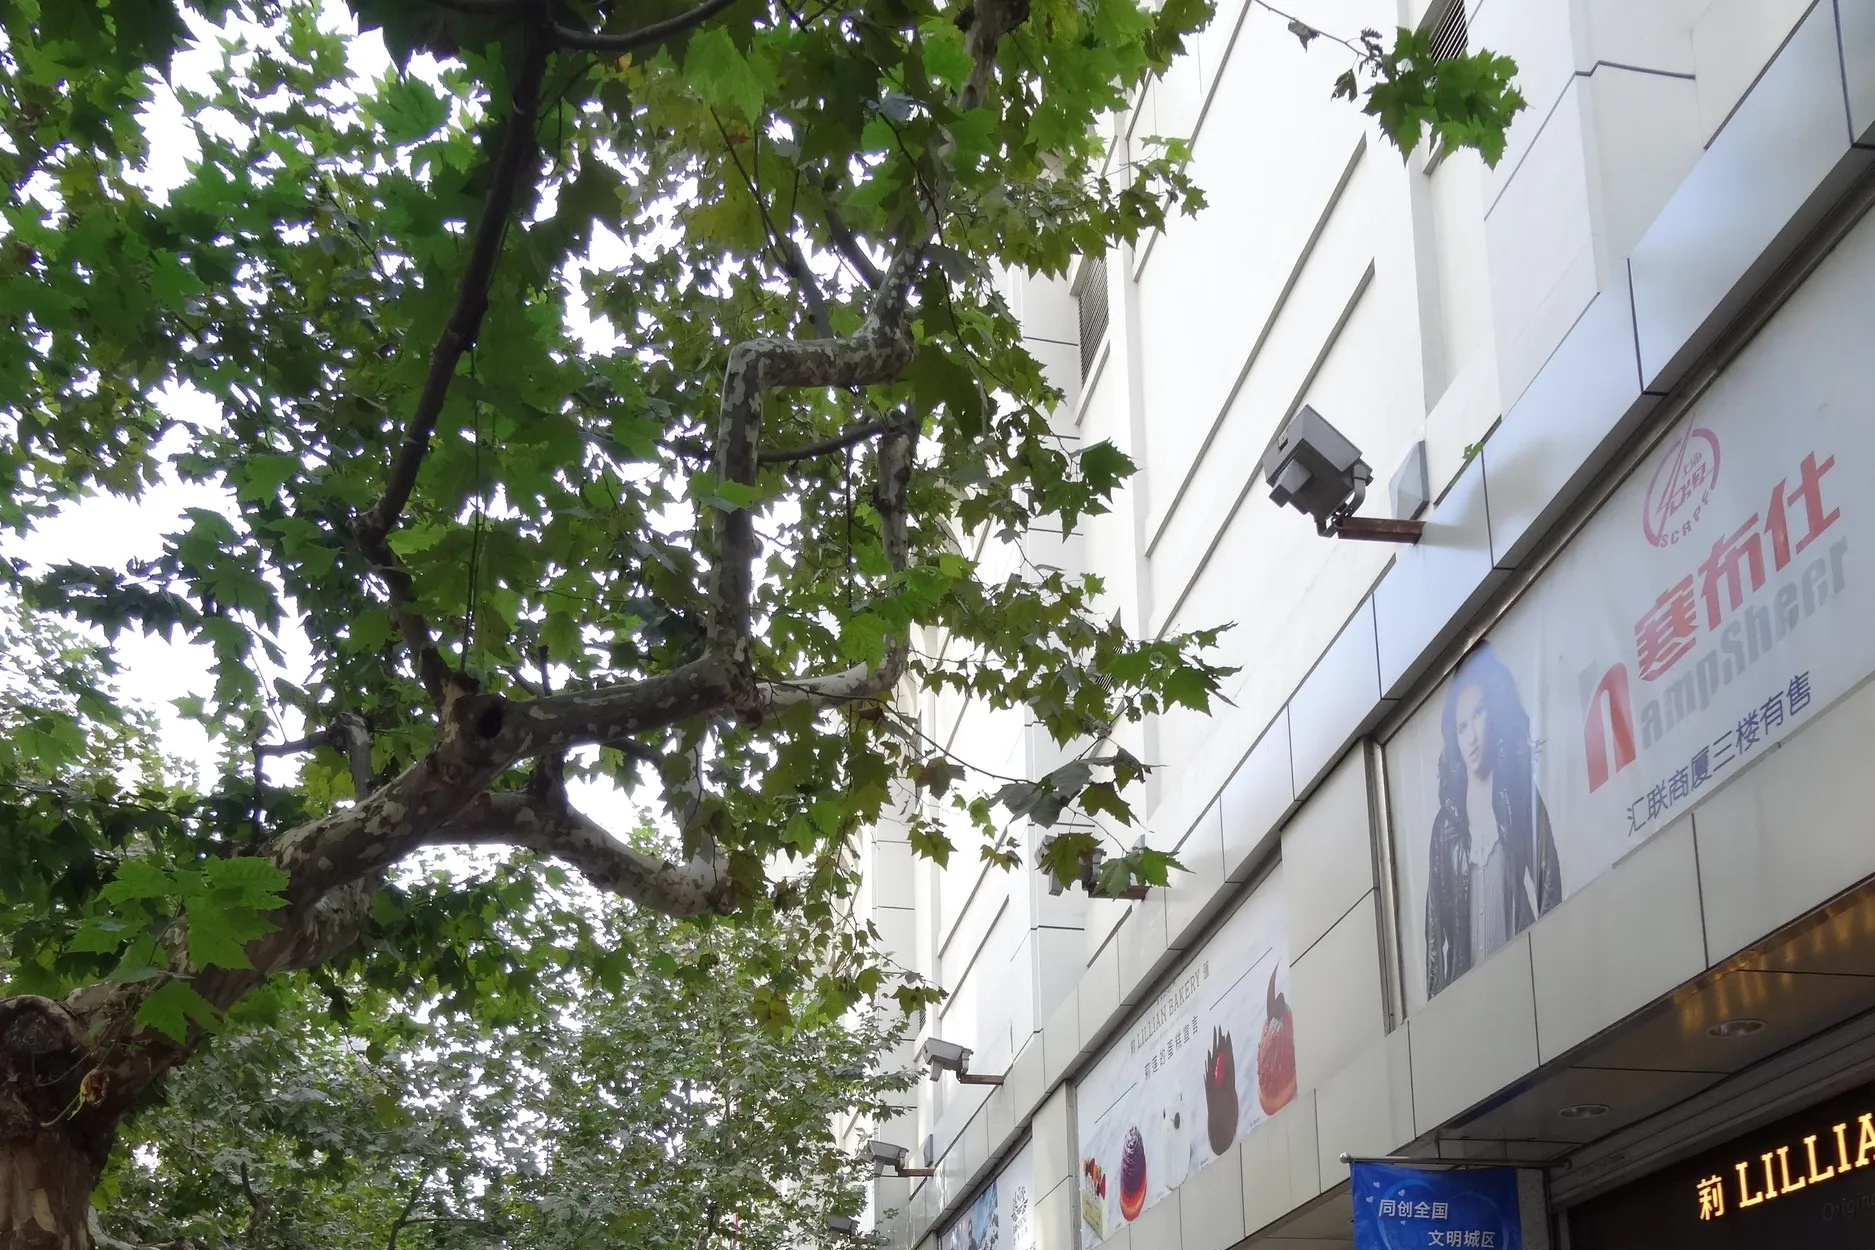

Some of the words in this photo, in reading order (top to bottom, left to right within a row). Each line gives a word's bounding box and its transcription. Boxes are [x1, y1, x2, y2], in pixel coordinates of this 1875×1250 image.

[1627, 671, 1812, 837] 汇联商厦三楼有售
[1137, 1005, 1167, 1050] LILLIAN
[1169, 969, 1201, 1017] BAKERY
[1378, 1199, 1449, 1220] 同创全国
[1428, 1230, 1496, 1248] 文明城区
